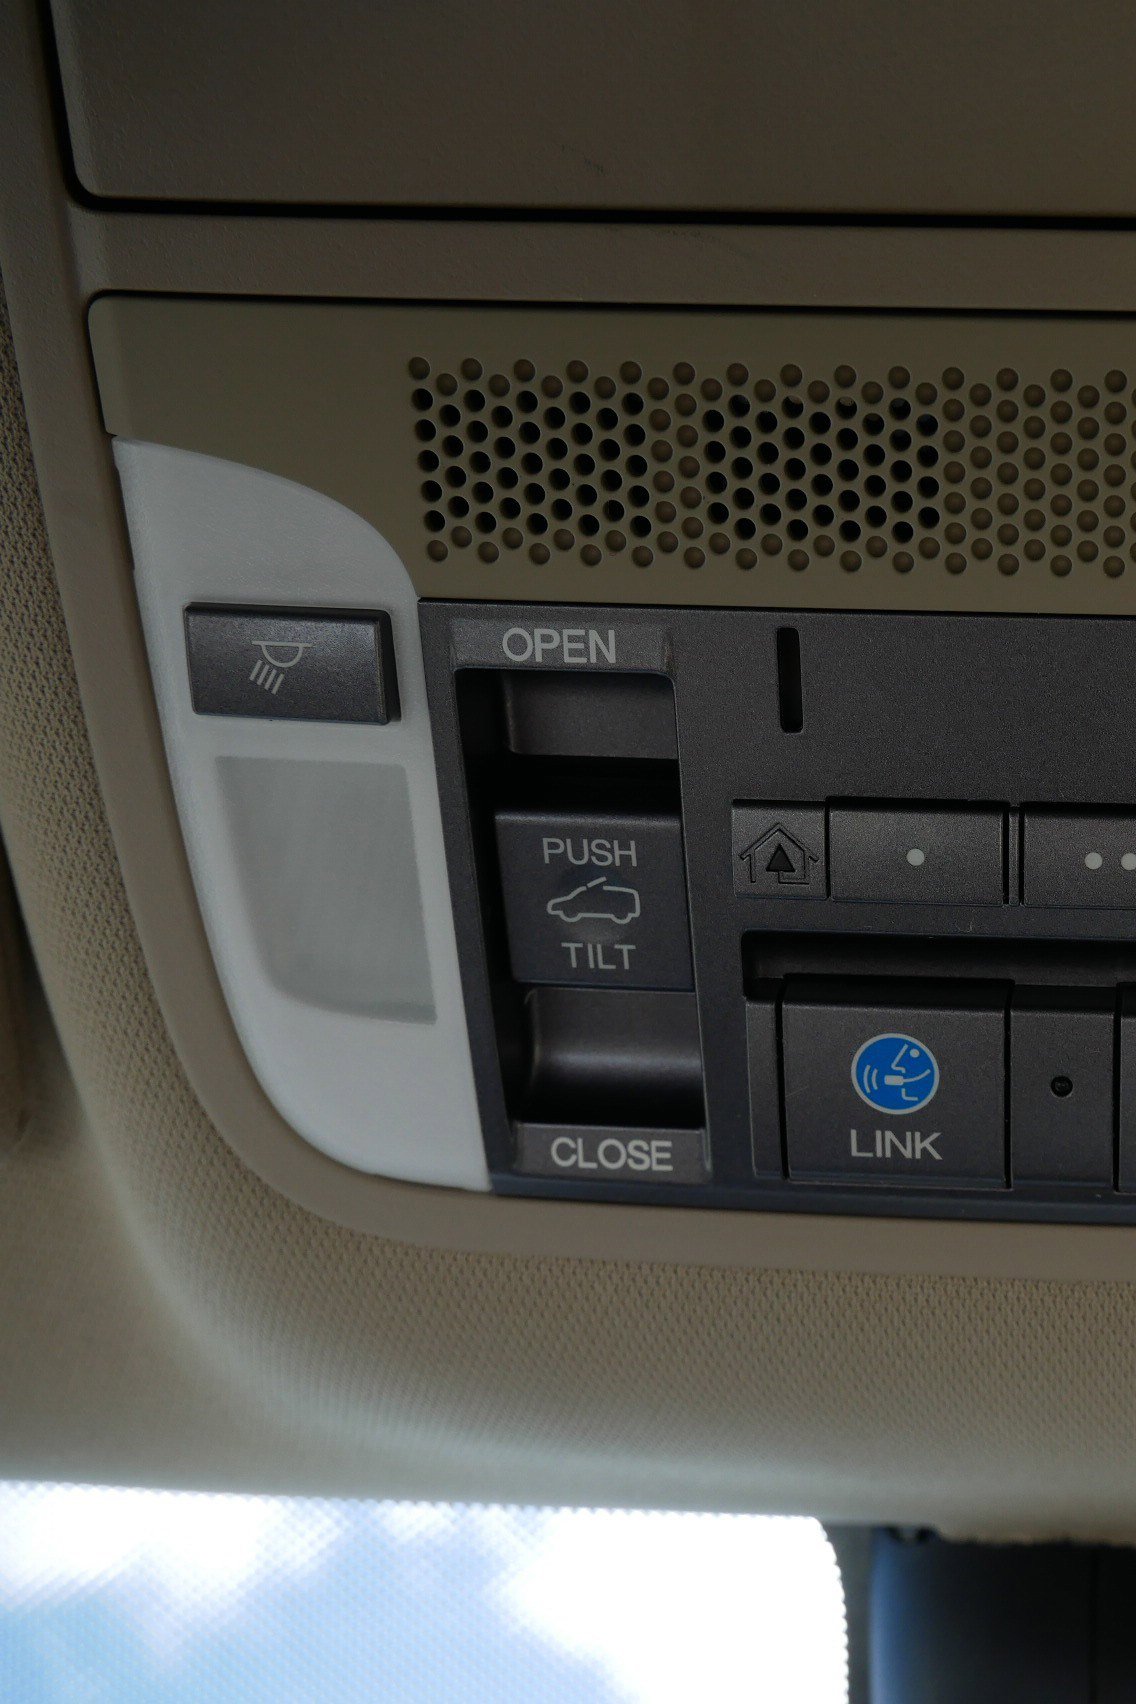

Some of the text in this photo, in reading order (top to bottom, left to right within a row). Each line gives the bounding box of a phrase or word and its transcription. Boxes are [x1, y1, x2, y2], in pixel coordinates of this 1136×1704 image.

[502, 627, 617, 664] OPEN
[542, 837, 638, 867] PUSH
[561, 942, 636, 970] TILT
[551, 1138, 674, 1171] CLOSE
[850, 1129, 943, 1160] LINK
